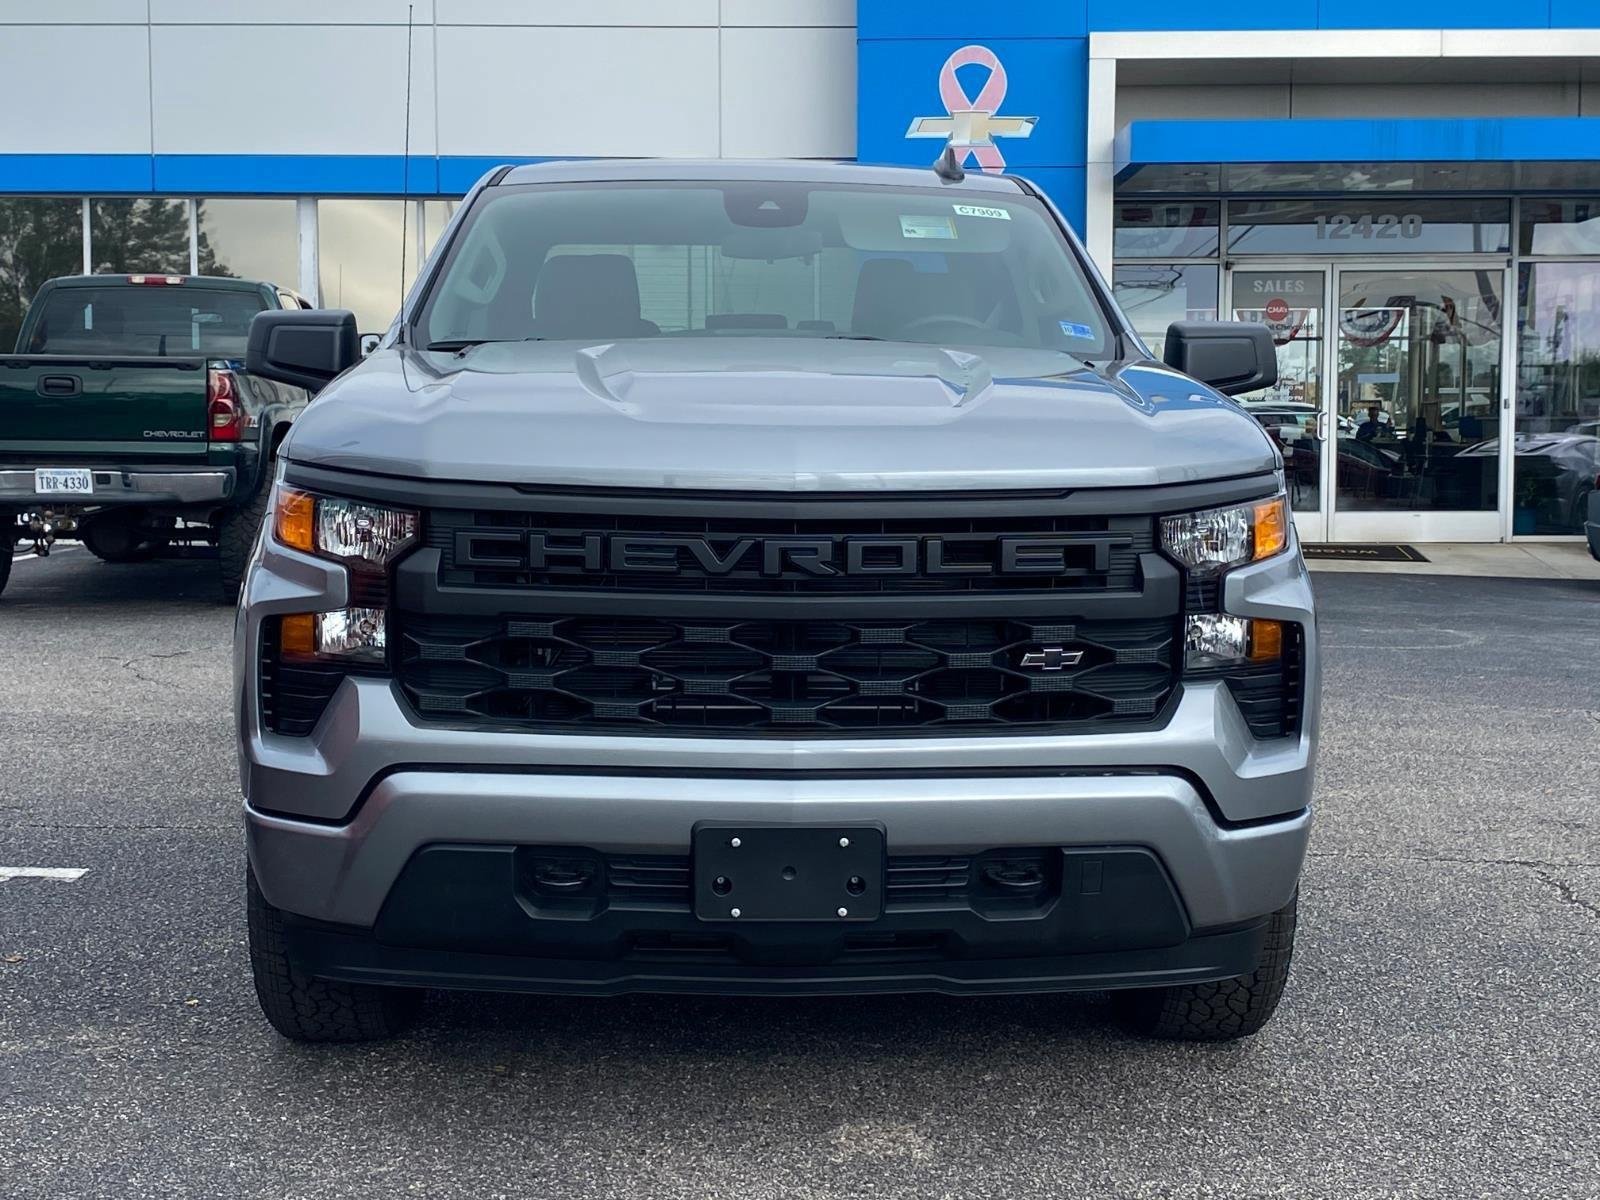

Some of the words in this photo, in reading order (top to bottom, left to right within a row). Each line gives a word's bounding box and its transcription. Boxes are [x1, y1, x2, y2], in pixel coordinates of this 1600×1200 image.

[959, 206, 1002, 217] C7909
[1314, 214, 1422, 239] 12420
[1253, 279, 1304, 293] SALES
[143, 430, 205, 438] CHEVROLET
[39, 476, 89, 490] TRR-4330
[453, 528, 1134, 577] CHEVROLET
